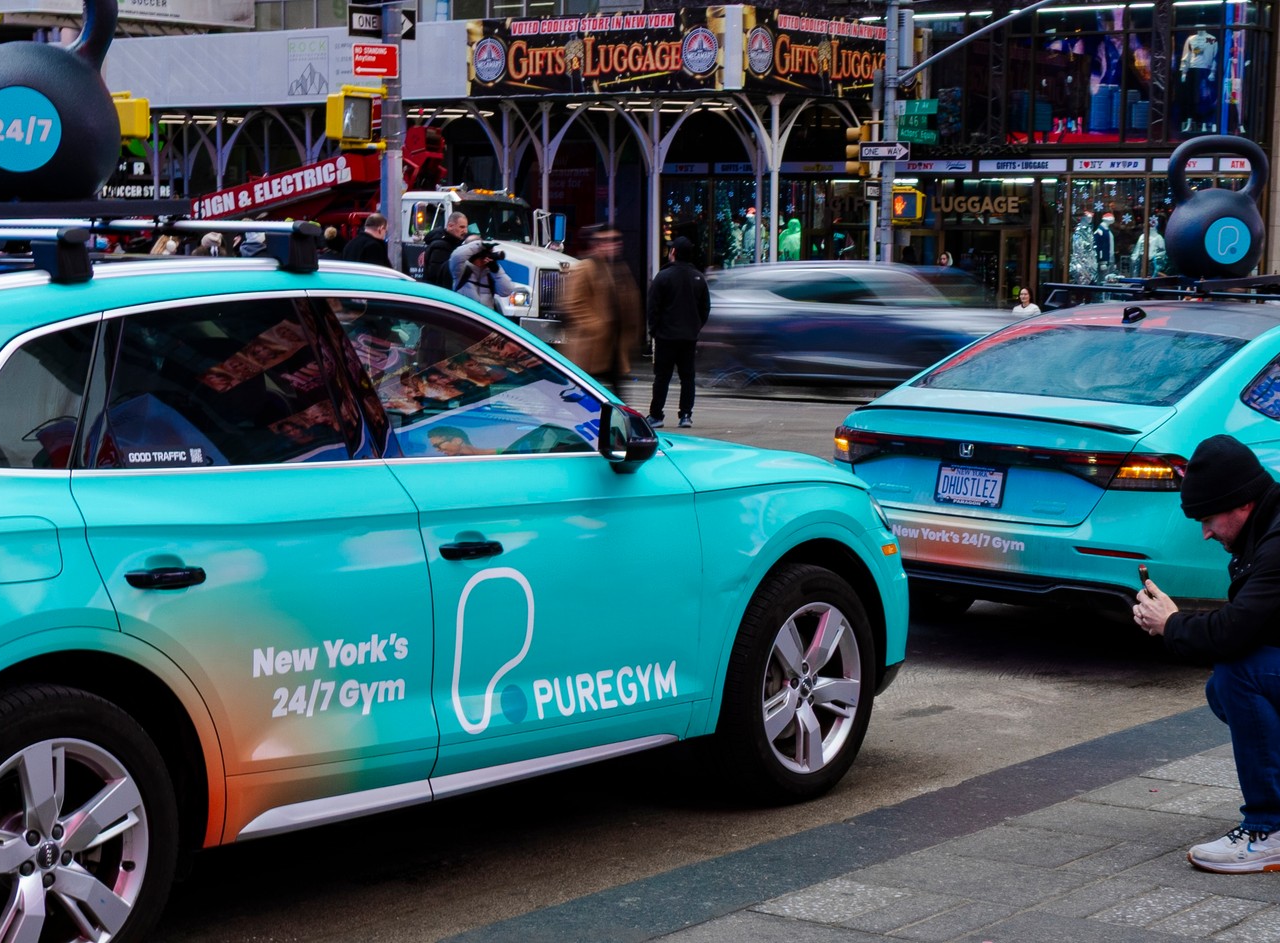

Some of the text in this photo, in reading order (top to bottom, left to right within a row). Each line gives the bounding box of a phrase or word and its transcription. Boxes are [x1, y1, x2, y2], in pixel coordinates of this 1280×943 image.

[358, 15, 377, 28] ONE
[511, 13, 675, 36] VOTED COOLEST STORE IN NEW YORK
[778, 14, 887, 41] VOTED COOLEST STORE IN NEW YOR
[572, 57, 581, 70] &
[909, 116, 919, 128] 46
[864, 147, 901, 155] ONE WAY
[1021, 161, 1049, 169] LUGGAGE
[1231, 160, 1245, 168] ATM
[193, 162, 337, 219] SIGN & ELECTRIC
[931, 196, 1020, 214] LUGGAGE
[129, 451, 186, 463] GOOD TRAFFIC
[942, 475, 998, 499] DHUSTLEZ
[892, 524, 1025, 553] New York's 24/7 Gym
[252, 633, 410, 678] New York's
[272, 677, 406, 719] 24/7 Gym
[532, 660, 678, 720] PUREGYM
